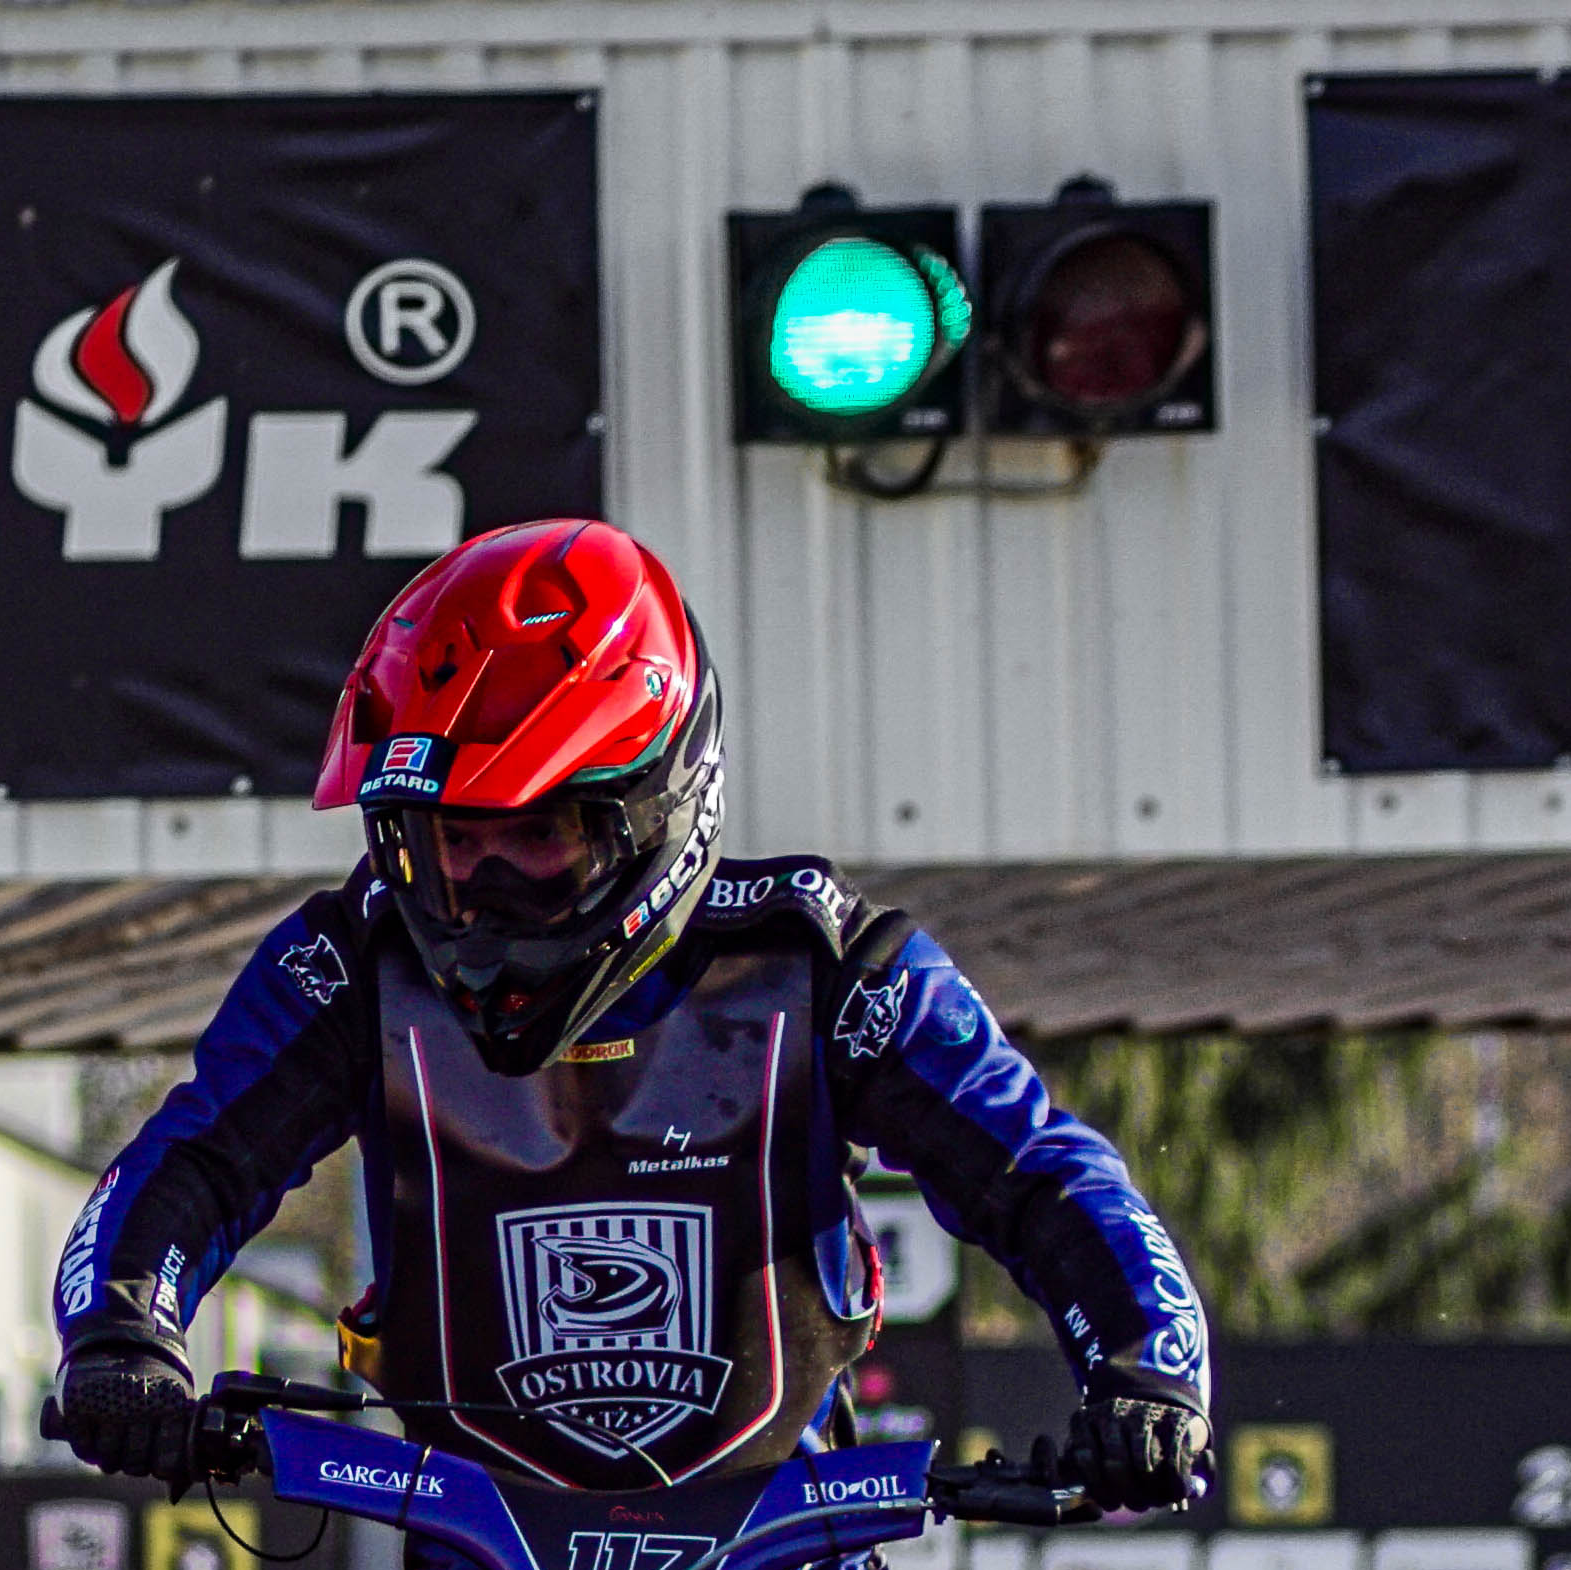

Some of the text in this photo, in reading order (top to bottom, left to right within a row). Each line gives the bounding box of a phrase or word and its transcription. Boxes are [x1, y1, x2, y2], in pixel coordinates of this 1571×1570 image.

[360, 774, 439, 794] BETARD
[707, 876, 775, 908] BIO
[628, 1153, 730, 1175] Metalkas
[520, 1360, 705, 1400] OSTROVIA
[863, 1475, 906, 1499] OIL
